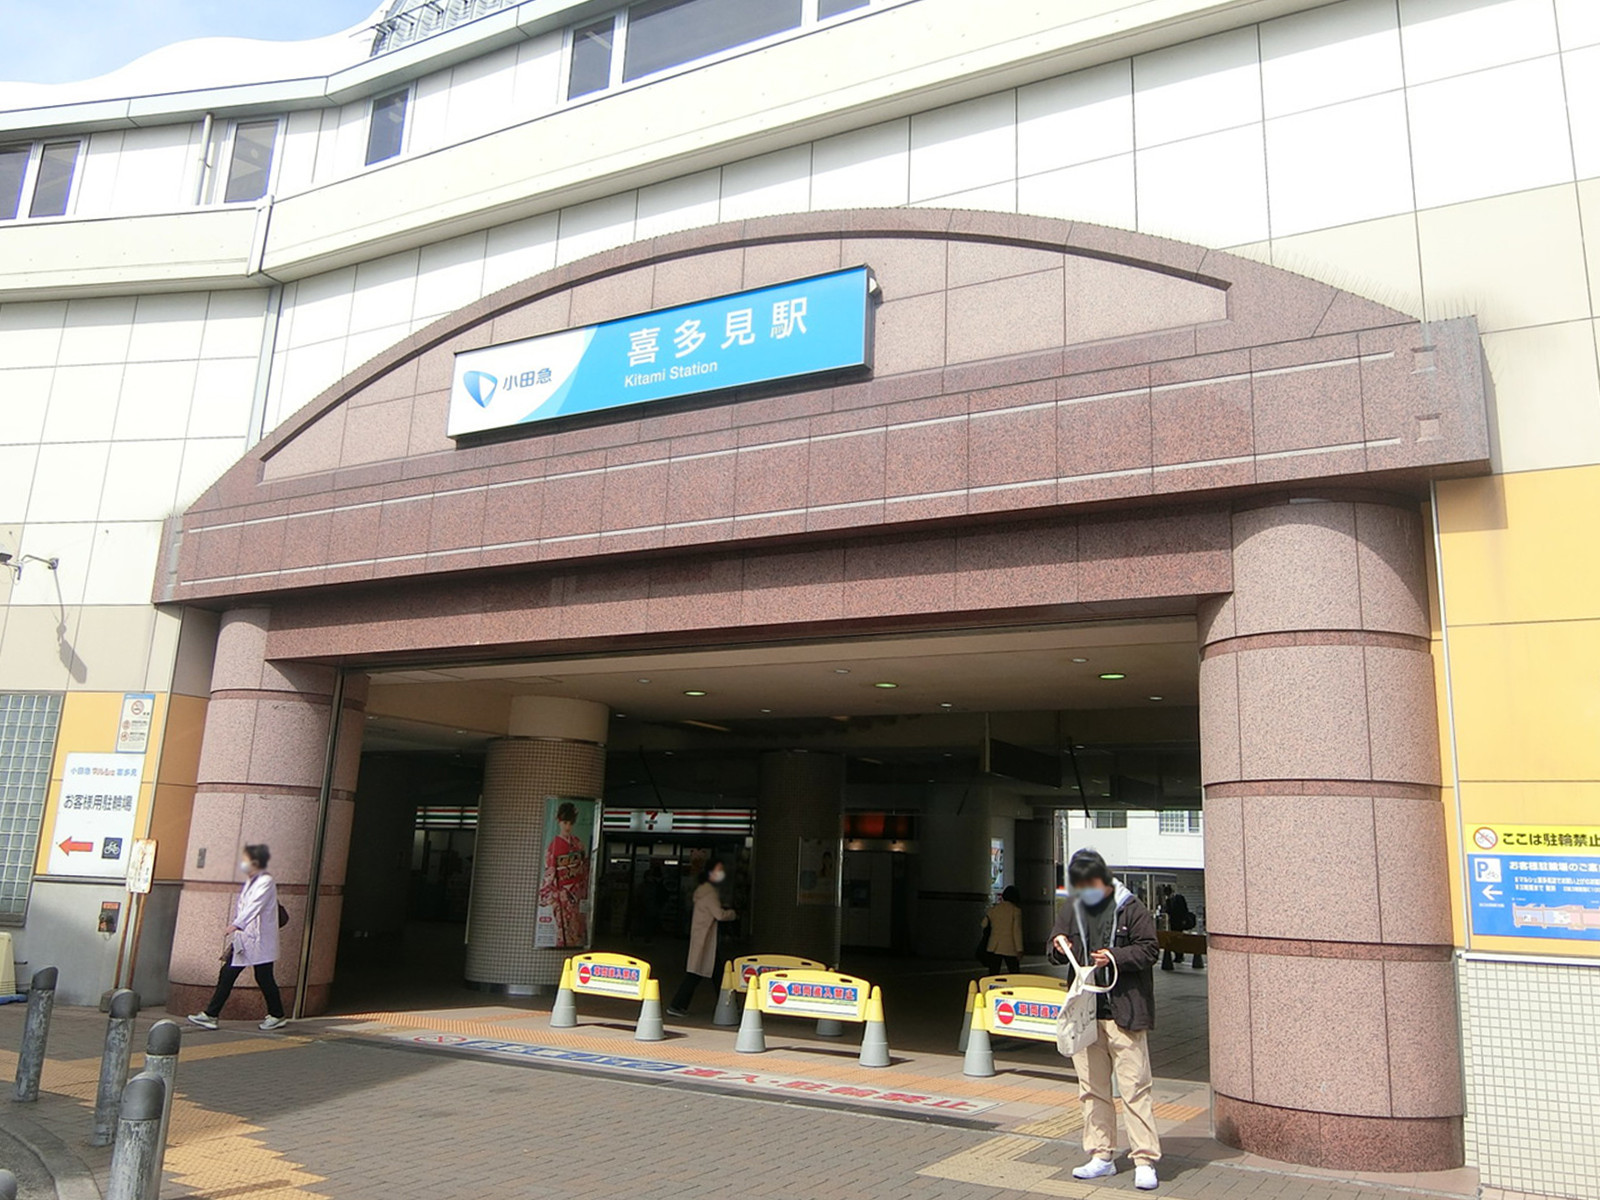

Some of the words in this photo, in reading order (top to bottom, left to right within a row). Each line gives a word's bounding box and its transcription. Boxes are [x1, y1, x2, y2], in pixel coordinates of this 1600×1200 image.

[627, 297, 808, 367] 喜多見駅
[503, 366, 552, 392] 小田急
[624, 367, 666, 388] Kitami
[669, 360, 718, 380] Station
[64, 794, 133, 811] お客様用駐輪場
[1503, 833, 1600, 847] ここは駐輪禁止
[792, 984, 855, 1000] 車両進入禁止
